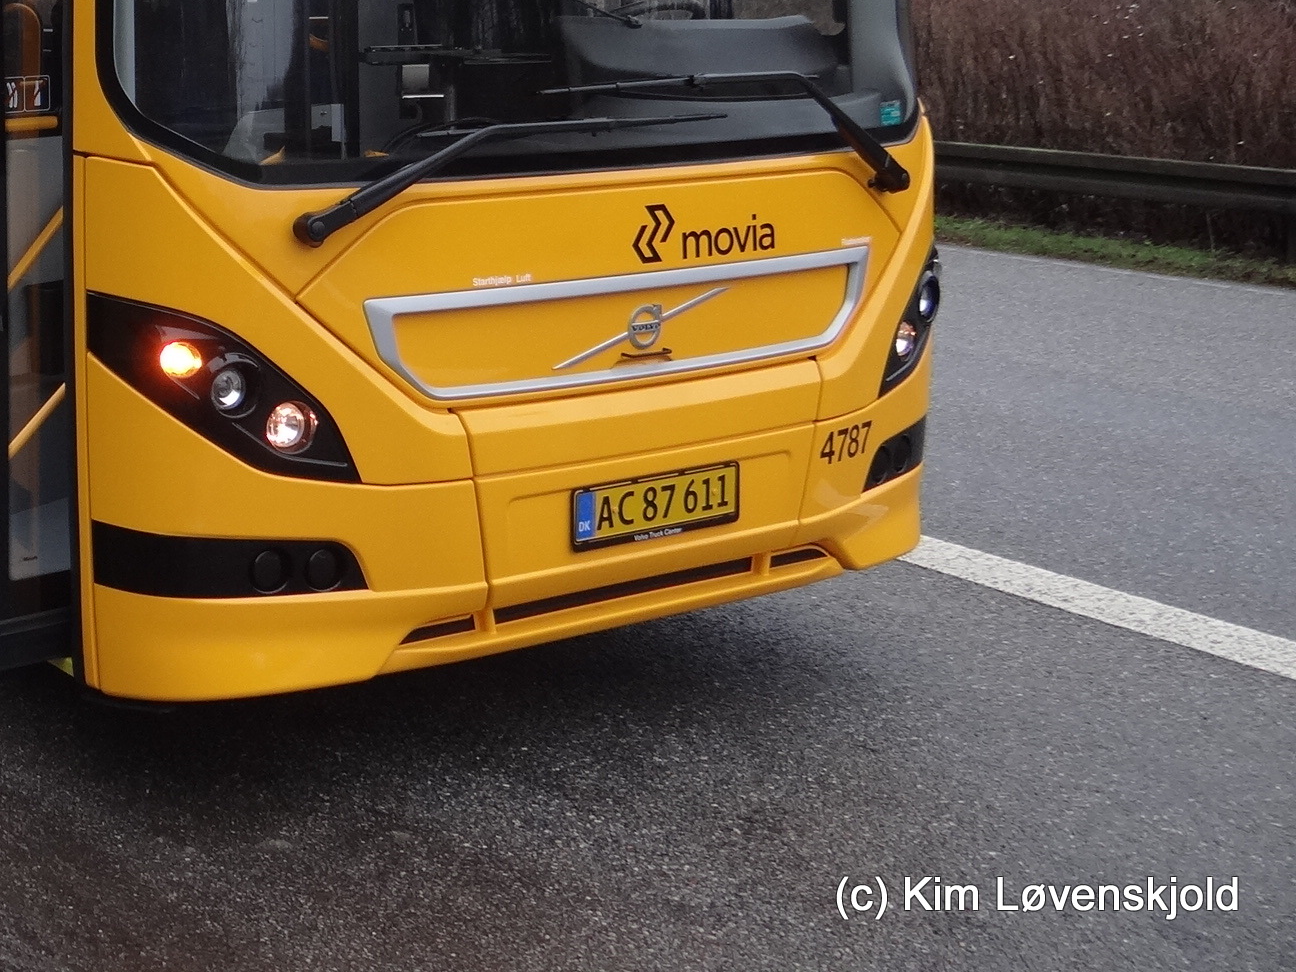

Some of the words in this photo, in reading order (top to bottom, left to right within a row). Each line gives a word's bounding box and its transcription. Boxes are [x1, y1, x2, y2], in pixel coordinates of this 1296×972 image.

[681, 214, 775, 260] movia
[515, 273, 532, 284] Luft
[631, 322, 660, 332] VOLVO
[819, 420, 873, 465] 4787
[596, 490, 635, 531] AC
[642, 484, 676, 522] 87
[683, 474, 729, 514] 611
[578, 520, 591, 532] DK
